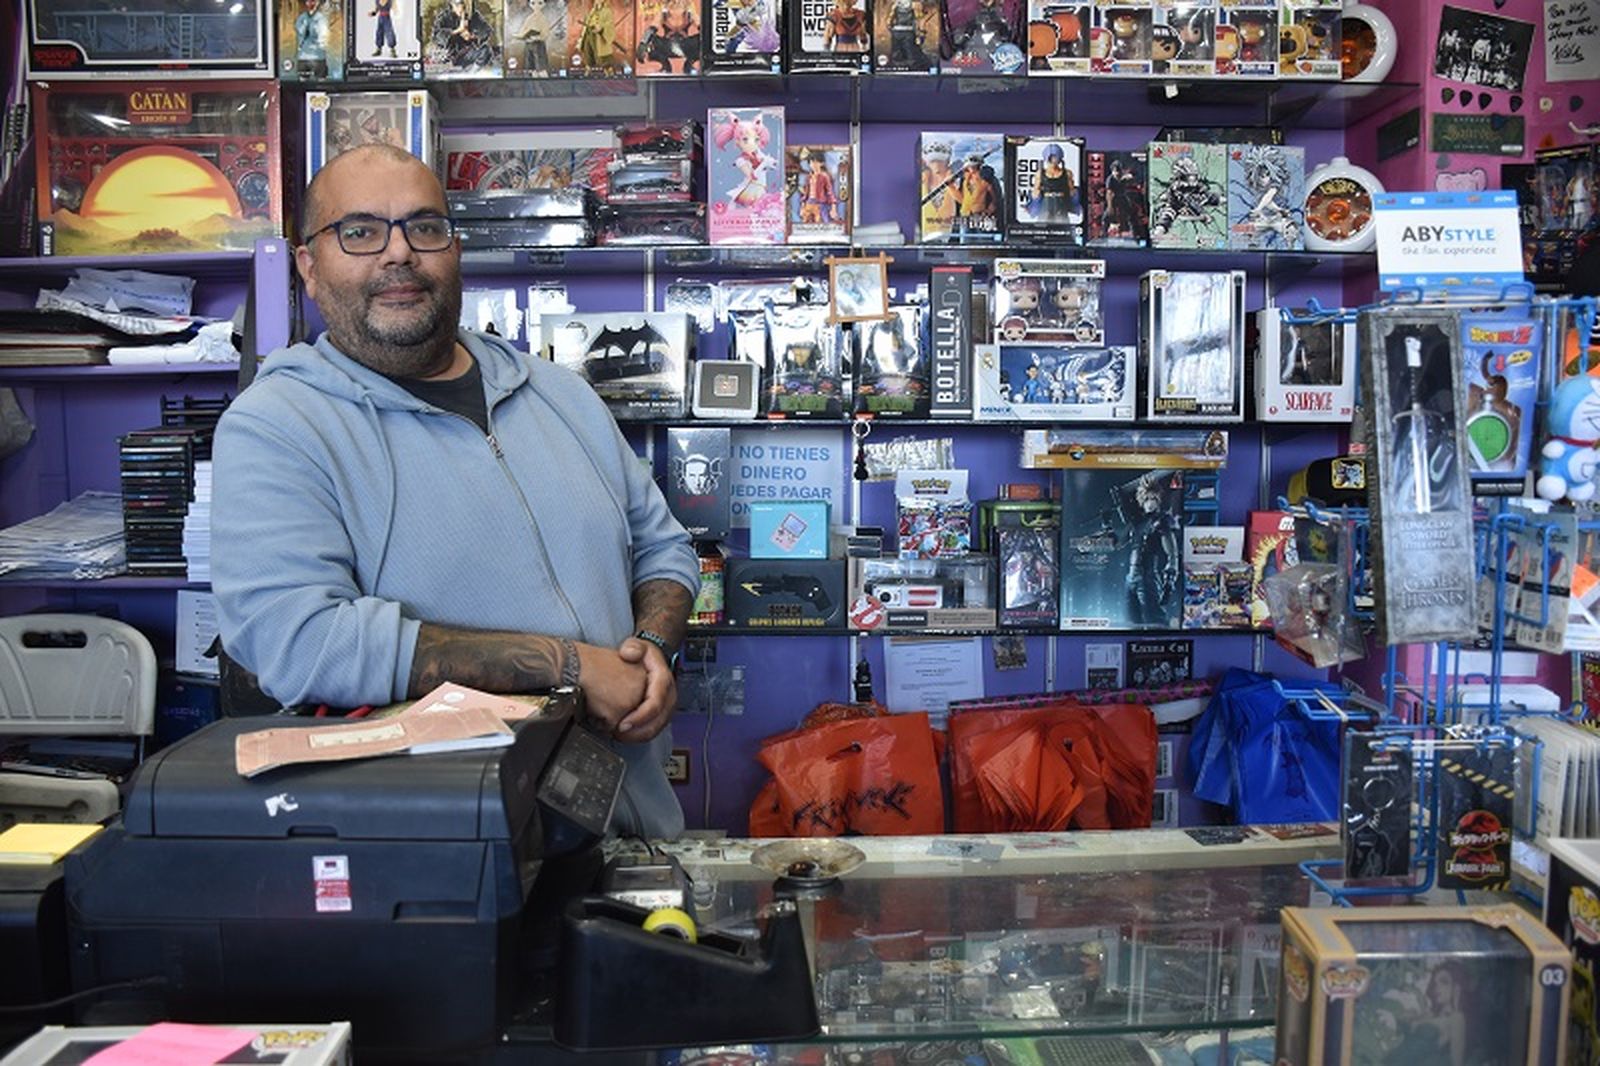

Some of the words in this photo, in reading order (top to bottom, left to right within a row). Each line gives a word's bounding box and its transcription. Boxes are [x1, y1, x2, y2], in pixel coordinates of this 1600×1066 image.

[130, 91, 187, 110] CATAN
[1401, 226, 1496, 242] ABYSTYLE
[1402, 246, 1419, 255] the
[1443, 247, 1497, 256] experience
[936, 307, 955, 403] BOTELLA
[1286, 392, 1333, 411] SCARFACE
[740, 446, 764, 459] NO
[769, 447, 831, 460] TIENES
[741, 466, 807, 480] DINERO
[781, 486, 833, 499] PAGAR
[731, 503, 751, 515] ON
[1541, 969, 1564, 985] 03
